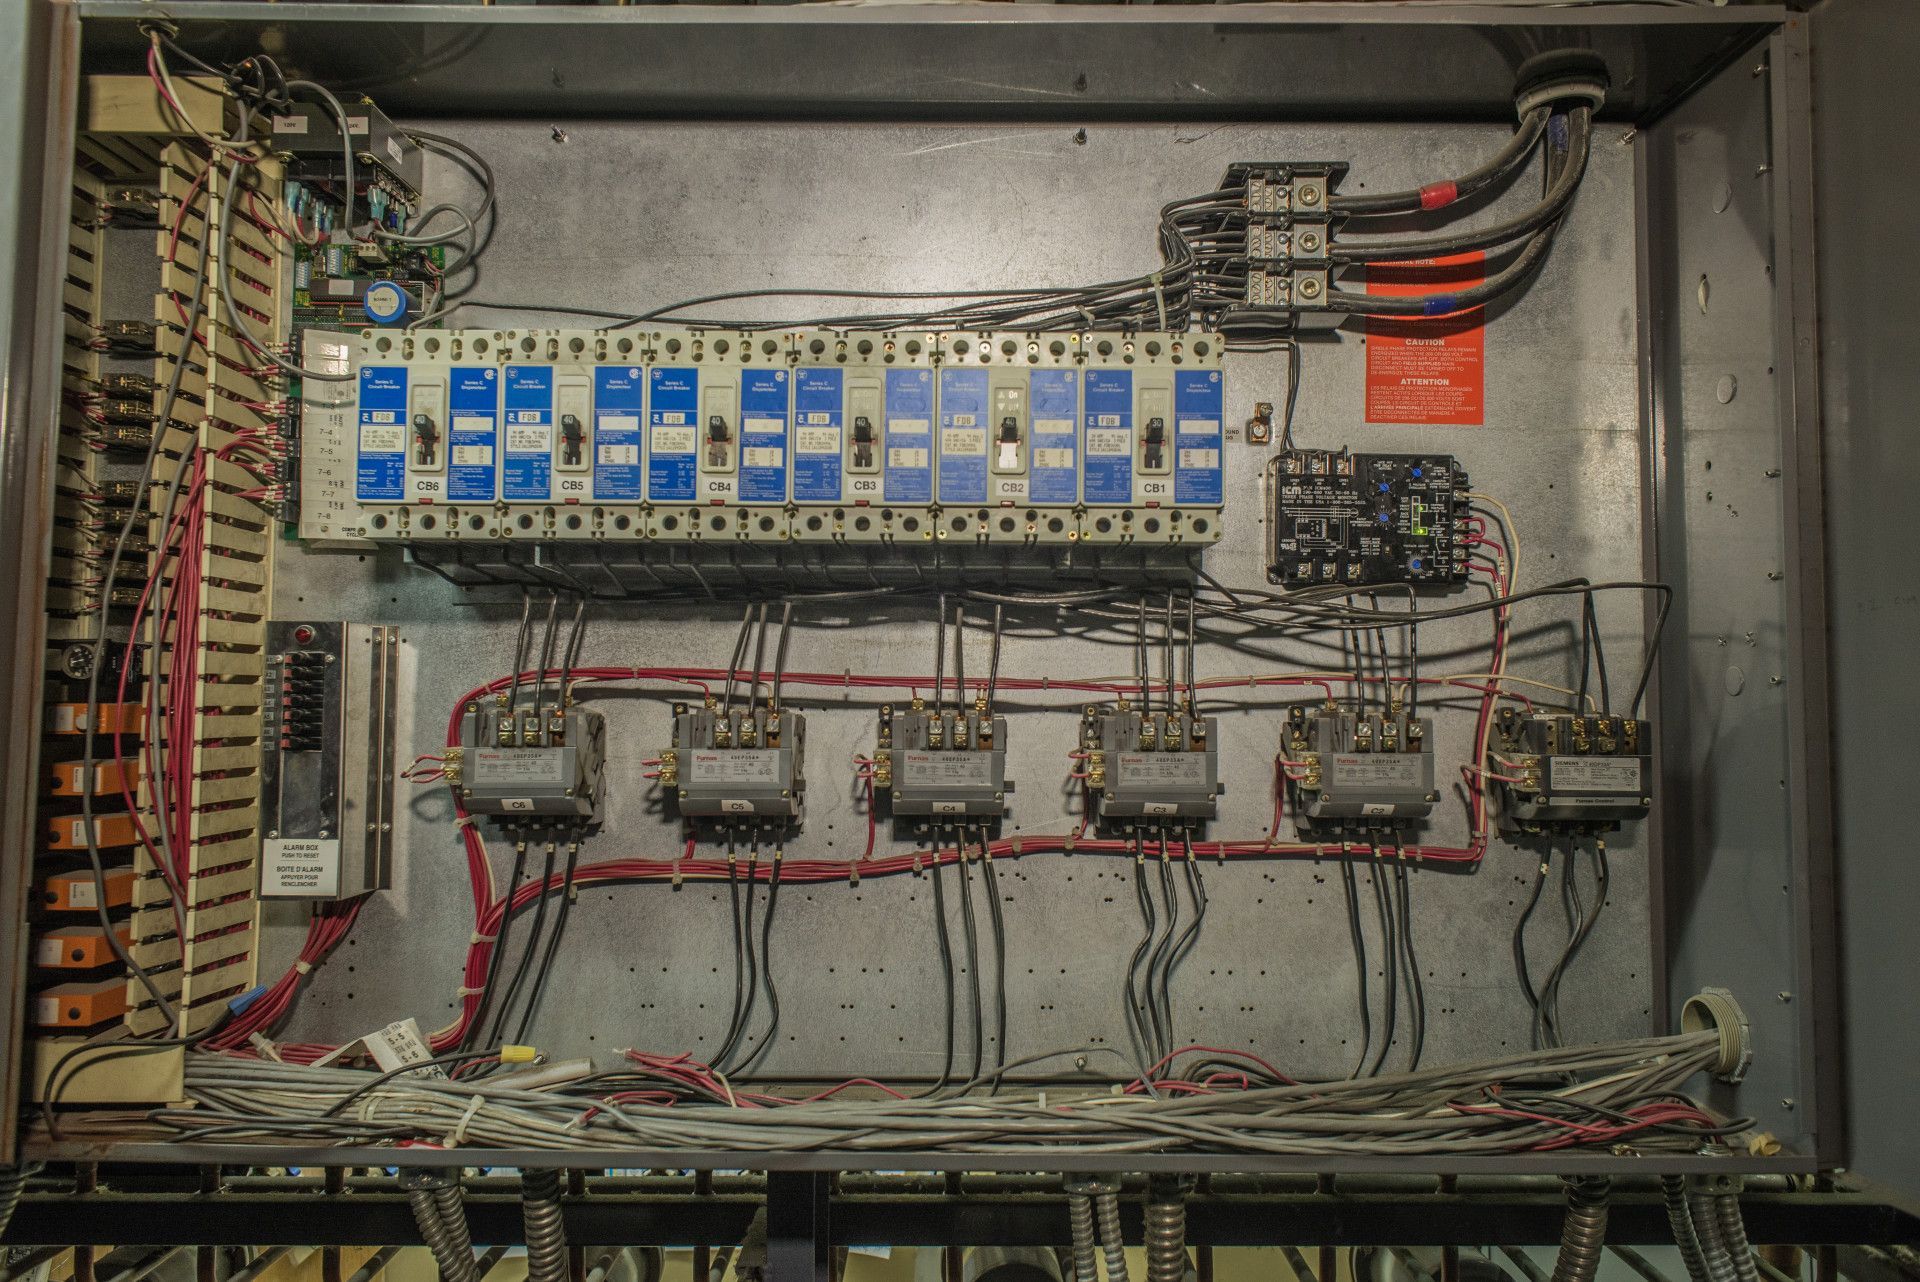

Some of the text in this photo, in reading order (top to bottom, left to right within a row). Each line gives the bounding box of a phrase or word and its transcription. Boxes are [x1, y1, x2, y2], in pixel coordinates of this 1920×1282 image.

[417, 481, 439, 491] CB6
[562, 481, 584, 490] CB5
[709, 482, 731, 492] CB4
[854, 481, 876, 491] CB3
[1002, 482, 1024, 492] CB2
[1144, 484, 1165, 493] CB1
